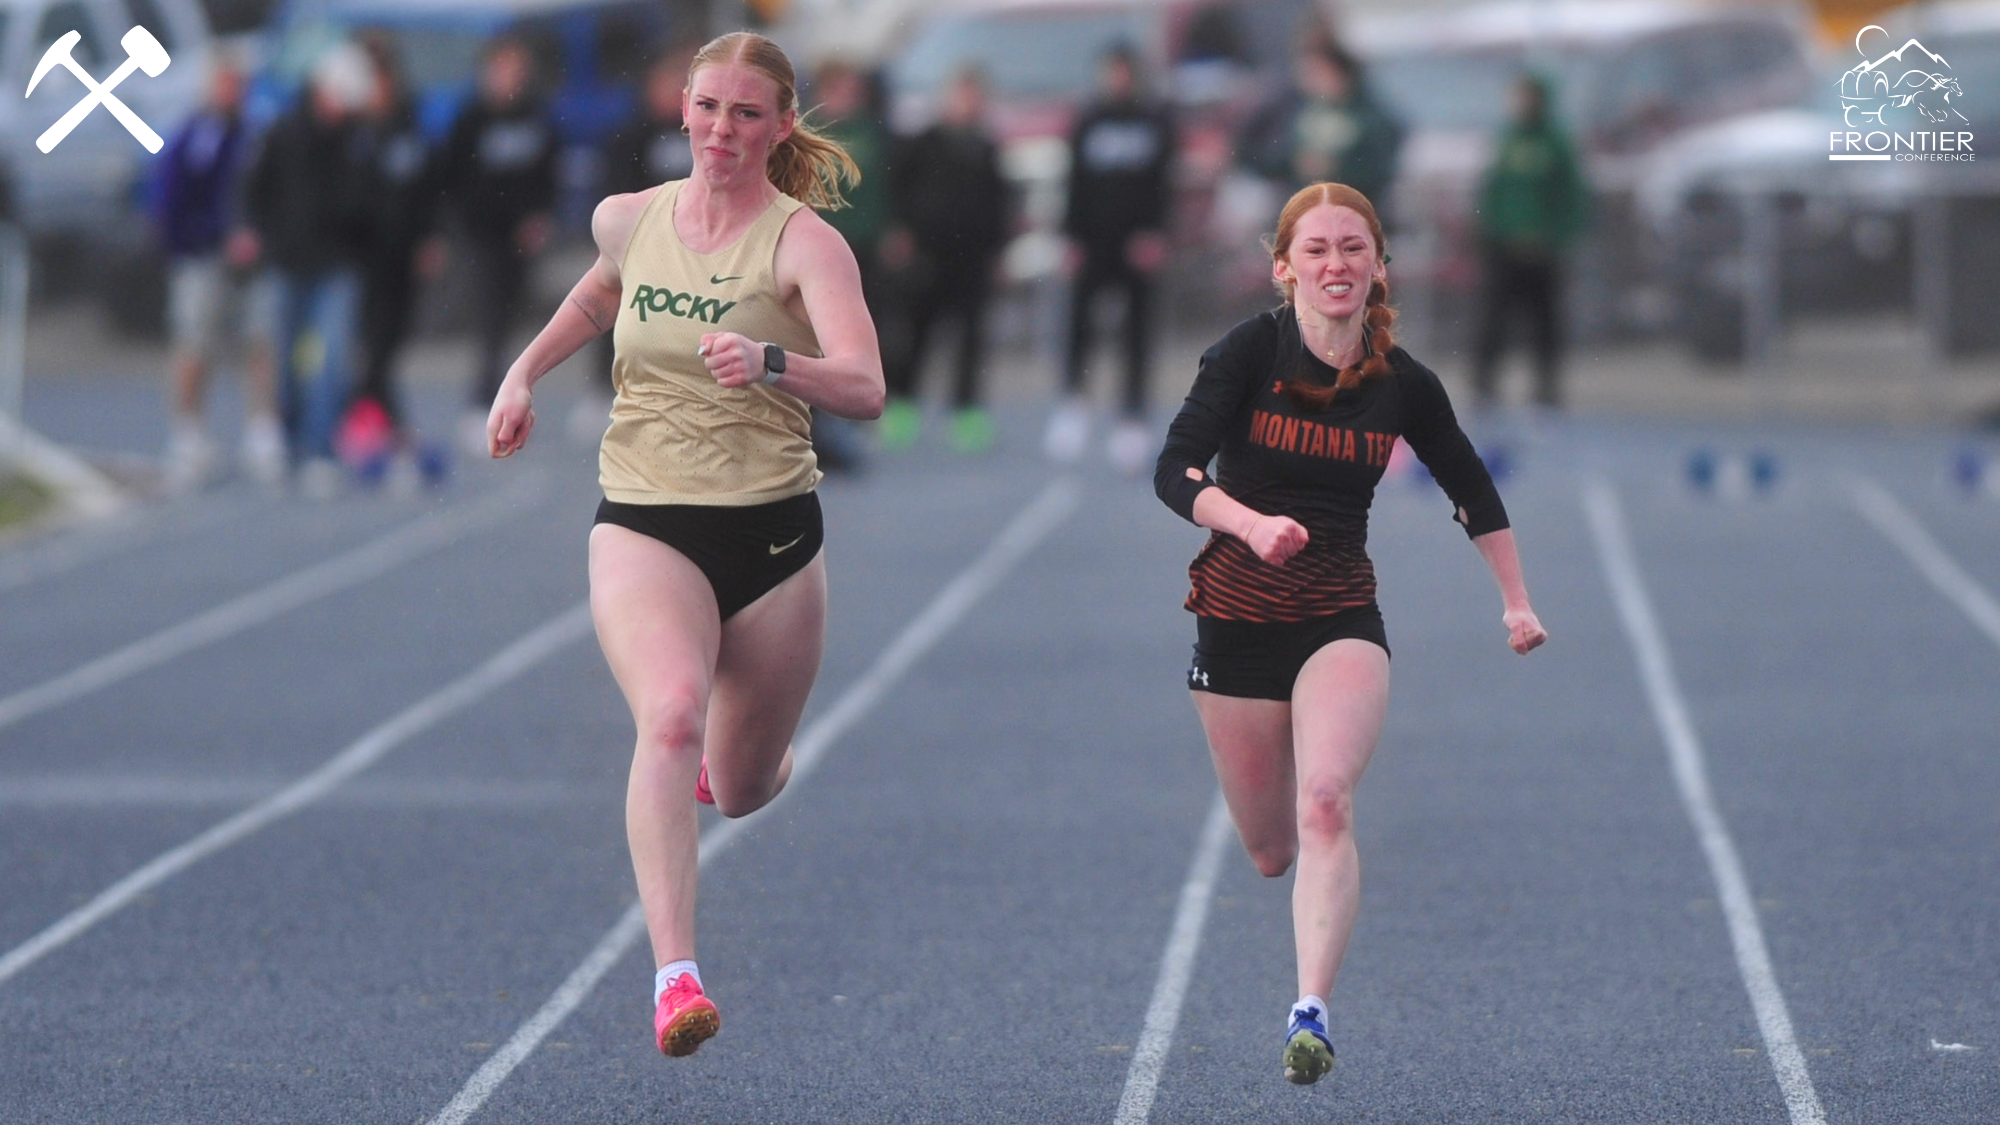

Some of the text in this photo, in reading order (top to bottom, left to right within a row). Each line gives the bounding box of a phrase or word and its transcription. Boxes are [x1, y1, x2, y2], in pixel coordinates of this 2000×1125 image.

[629, 284, 737, 324] ROCKY
[1250, 409, 1396, 467] MONTANA TEC
